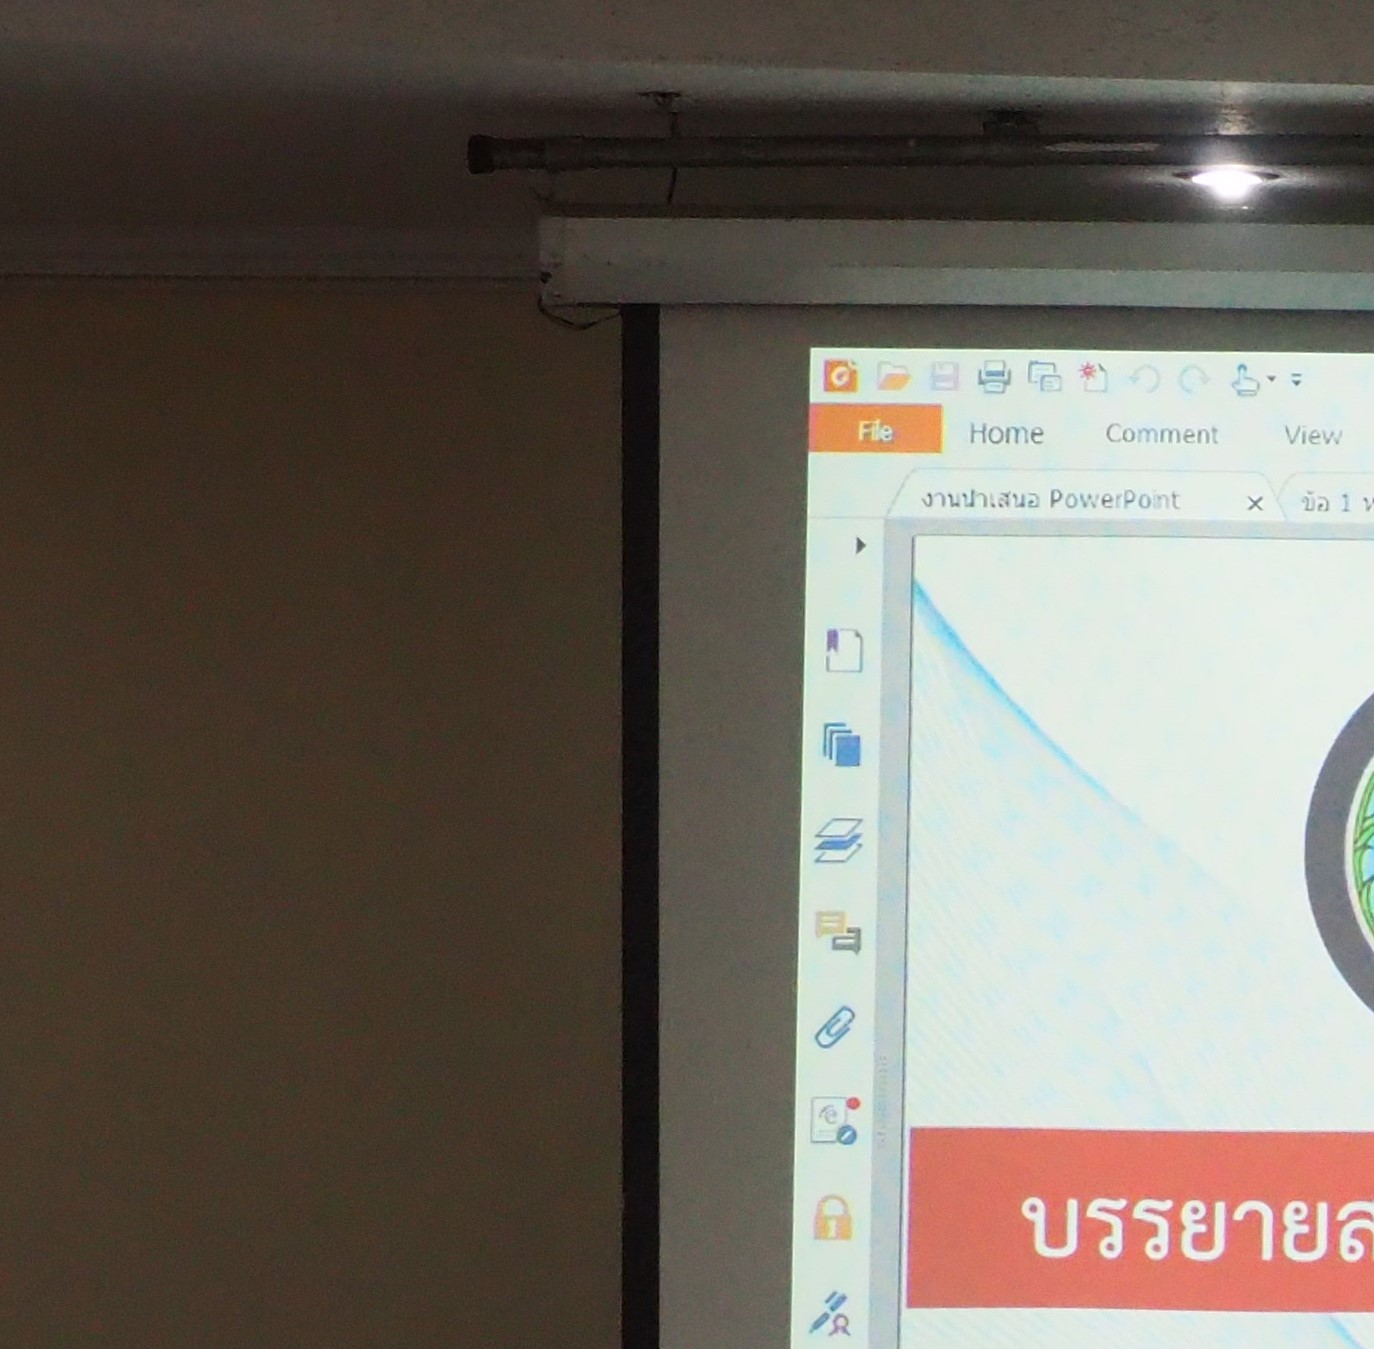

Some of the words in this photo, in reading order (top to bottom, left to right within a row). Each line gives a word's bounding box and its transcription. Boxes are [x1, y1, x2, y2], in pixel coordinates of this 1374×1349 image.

[858, 418, 893, 442] File
[970, 423, 1045, 445] Home
[1105, 422, 1218, 445] Comment
[1284, 425, 1343, 445] View
[1049, 488, 1178, 510] PowerPoint
[1341, 493, 1350, 513] 1
